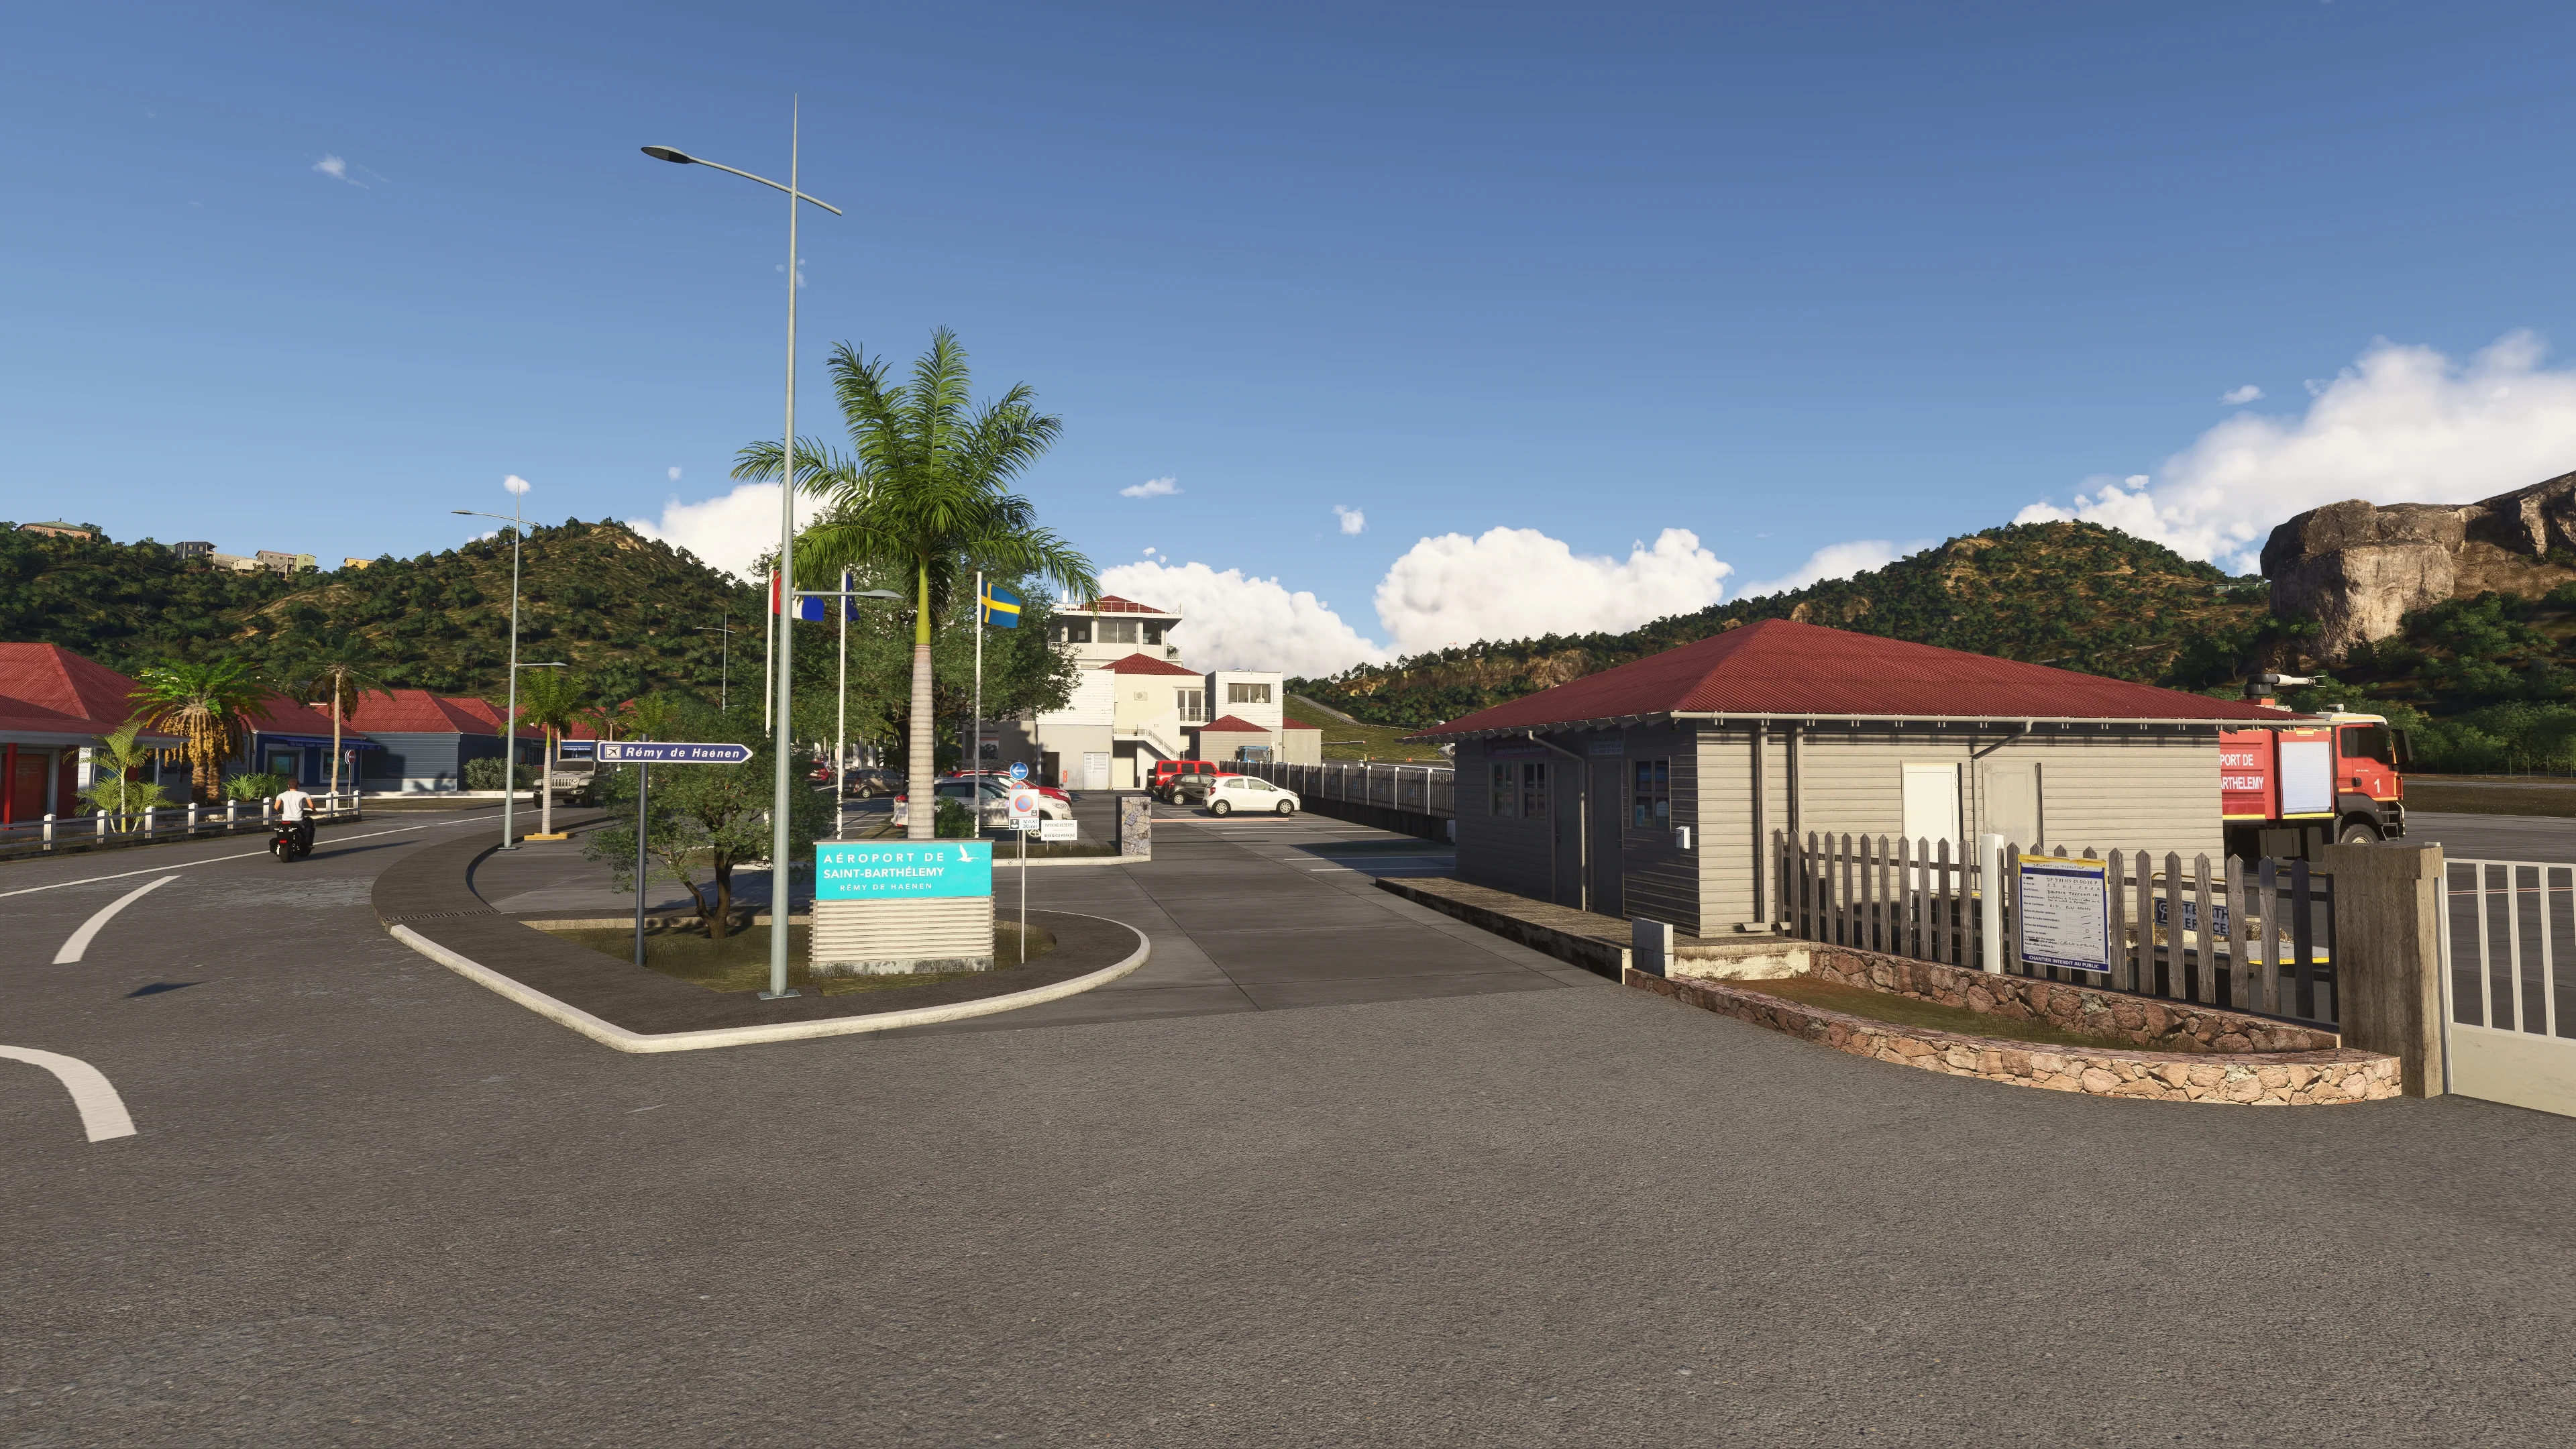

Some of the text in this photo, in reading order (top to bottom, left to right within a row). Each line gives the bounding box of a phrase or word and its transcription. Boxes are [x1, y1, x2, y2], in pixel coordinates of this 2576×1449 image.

[626, 747, 663, 759] Rémy
[670, 748, 686, 757] de
[2243, 753, 2253, 766] DE
[2374, 778, 2380, 794] 1
[823, 852, 944, 863] AÉROPORT DE
[823, 866, 945, 879] SAINT-BARTHÉLEMY
[840, 883, 867, 892] RÉMY
[2052, 957, 2074, 965] INTERDIT
